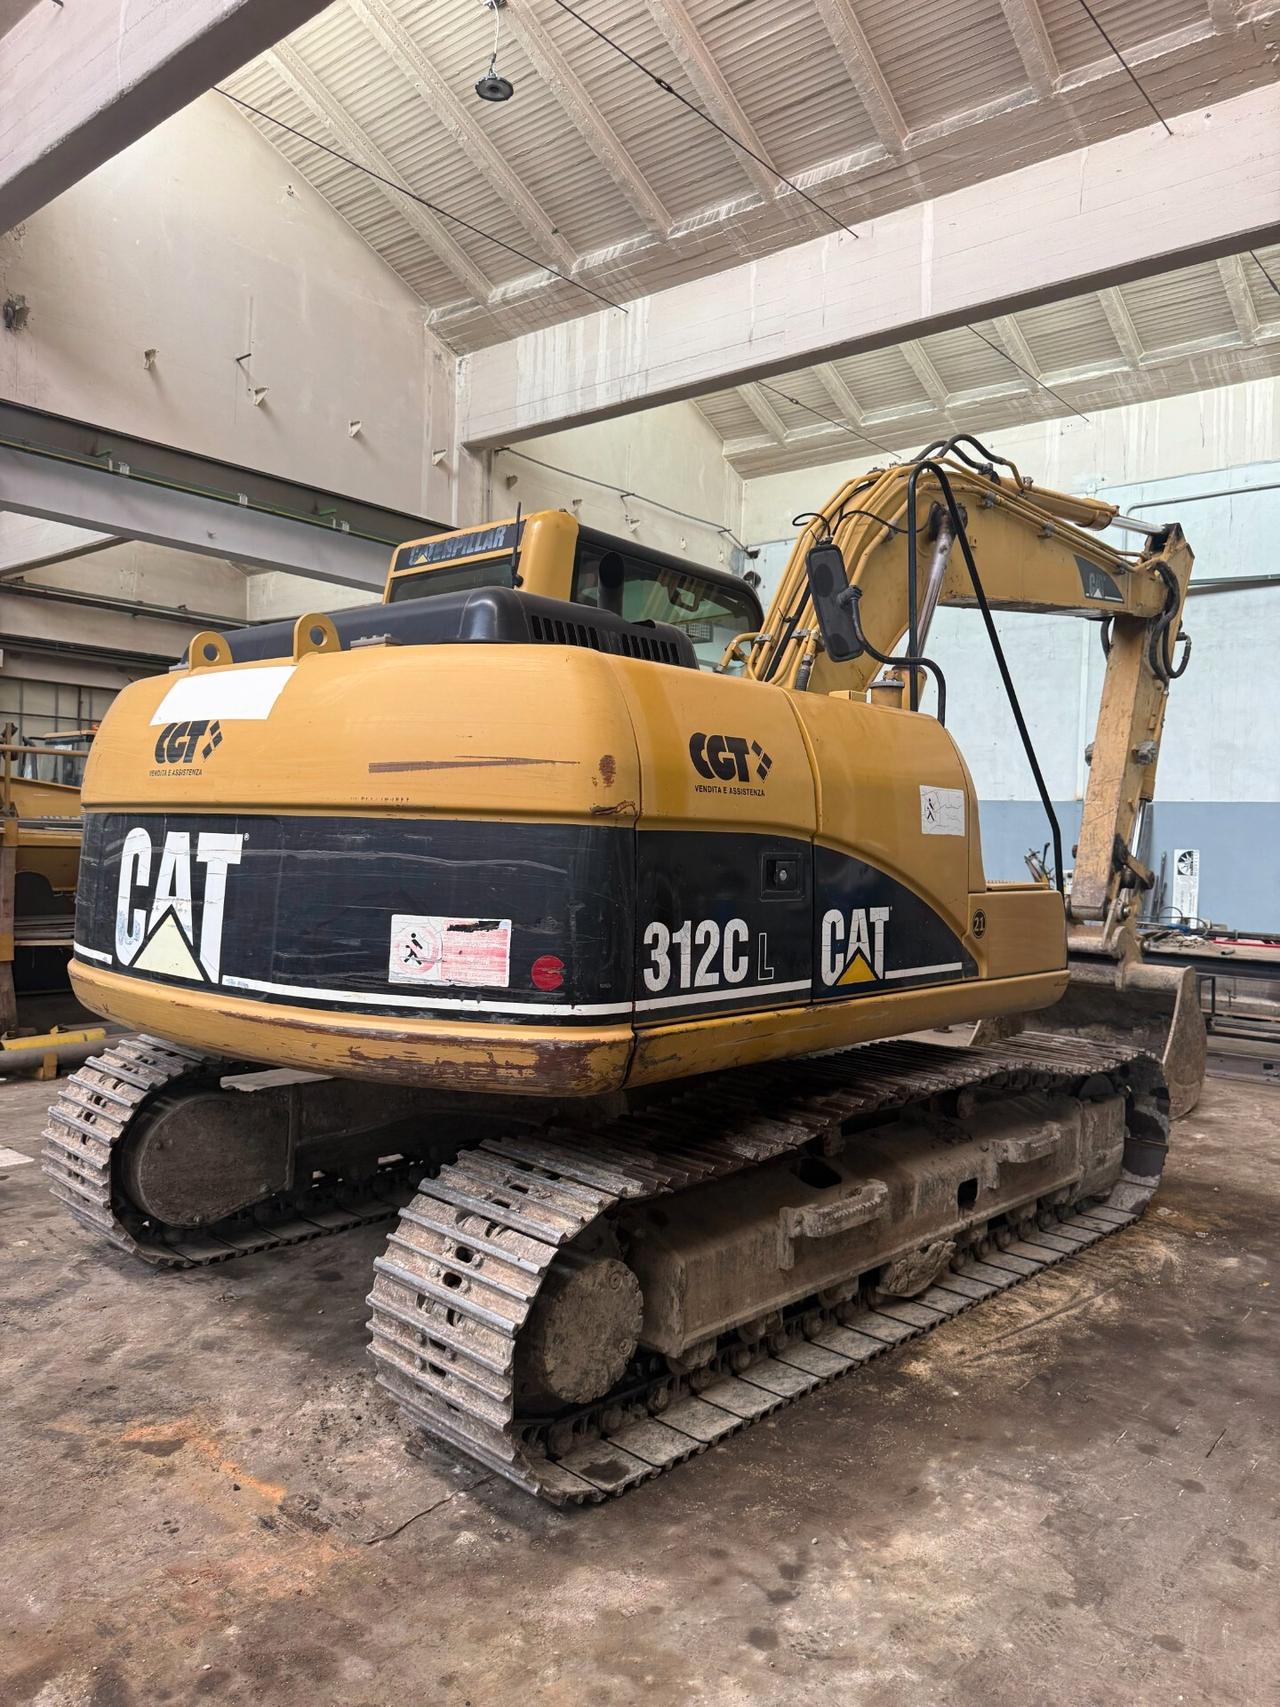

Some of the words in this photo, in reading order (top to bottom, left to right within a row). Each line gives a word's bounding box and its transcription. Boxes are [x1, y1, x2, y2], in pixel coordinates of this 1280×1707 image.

[408, 526, 507, 566] CATERPILLAR
[154, 719, 210, 764] CGT
[689, 731, 750, 783] CGT
[149, 769, 168, 777] VENDITA
[694, 784, 722, 794] VENDITA
[729, 786, 766, 797] ASSISTENZA
[115, 827, 243, 984] CAT
[643, 918, 749, 992] 312C
[757, 932, 775, 981] L
[821, 906, 890, 986] CAT
